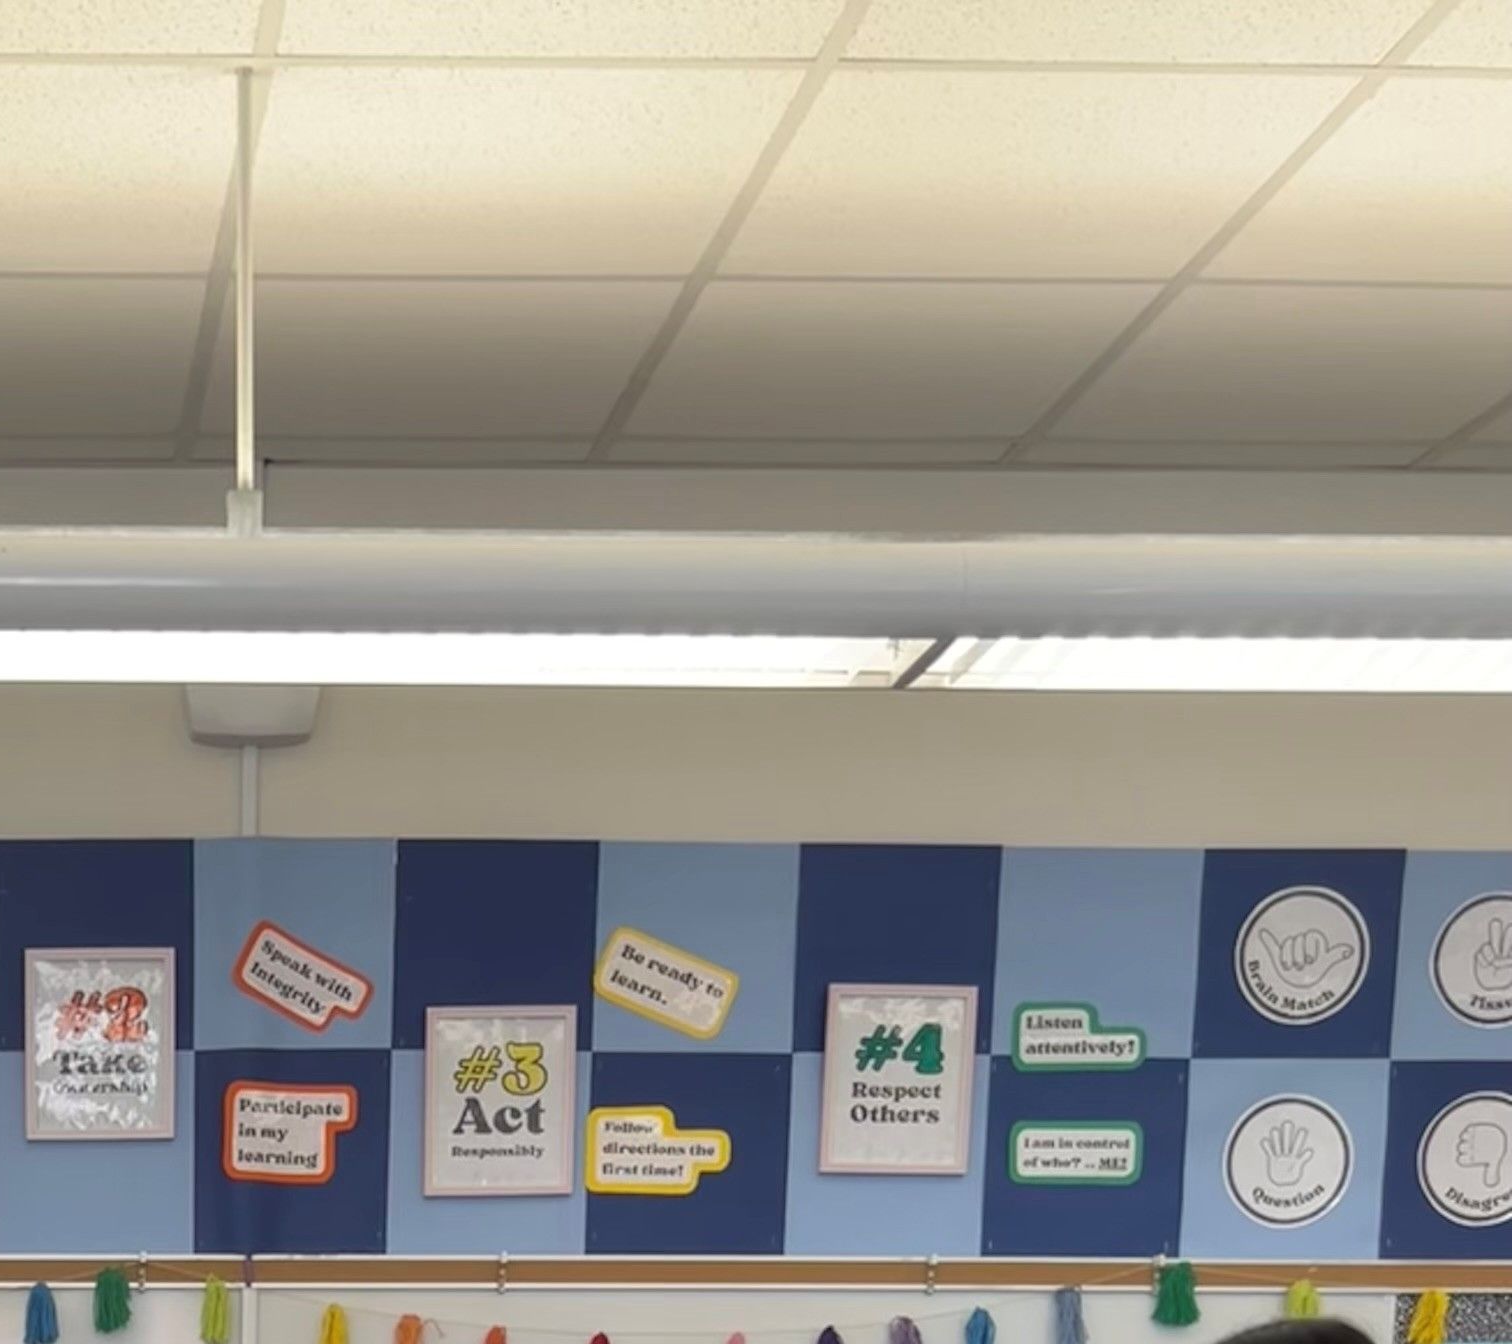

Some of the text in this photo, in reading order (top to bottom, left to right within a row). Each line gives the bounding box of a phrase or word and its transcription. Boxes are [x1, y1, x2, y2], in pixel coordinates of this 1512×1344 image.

[261, 940, 353, 1002] Speak with
[621, 943, 724, 999] Be ready to
[250, 961, 326, 1014] Integrity
[610, 970, 668, 1005] learn.
[1247, 960, 1336, 1012] Brain Match
[55, 986, 148, 1043] #2
[1026, 1015, 1083, 1030] Listen
[855, 1022, 944, 1075] #4
[1025, 1040, 1136, 1057] attentively!
[53, 1051, 147, 1074] Take
[453, 1040, 548, 1096] #3
[851, 1082, 942, 1102] Respect
[239, 1098, 343, 1118] Participate
[452, 1096, 546, 1135] Act
[850, 1104, 940, 1124] Others
[238, 1122, 288, 1143] in my
[604, 1121, 653, 1133] Follow
[451, 1144, 546, 1159] Responsibly
[602, 1142, 715, 1156] directions the
[1024, 1138, 1130, 1149] I am in control
[238, 1149, 319, 1168] learning
[1023, 1157, 1038, 1168] of
[602, 1163, 684, 1177] first time!
[1252, 1184, 1325, 1208] Question
